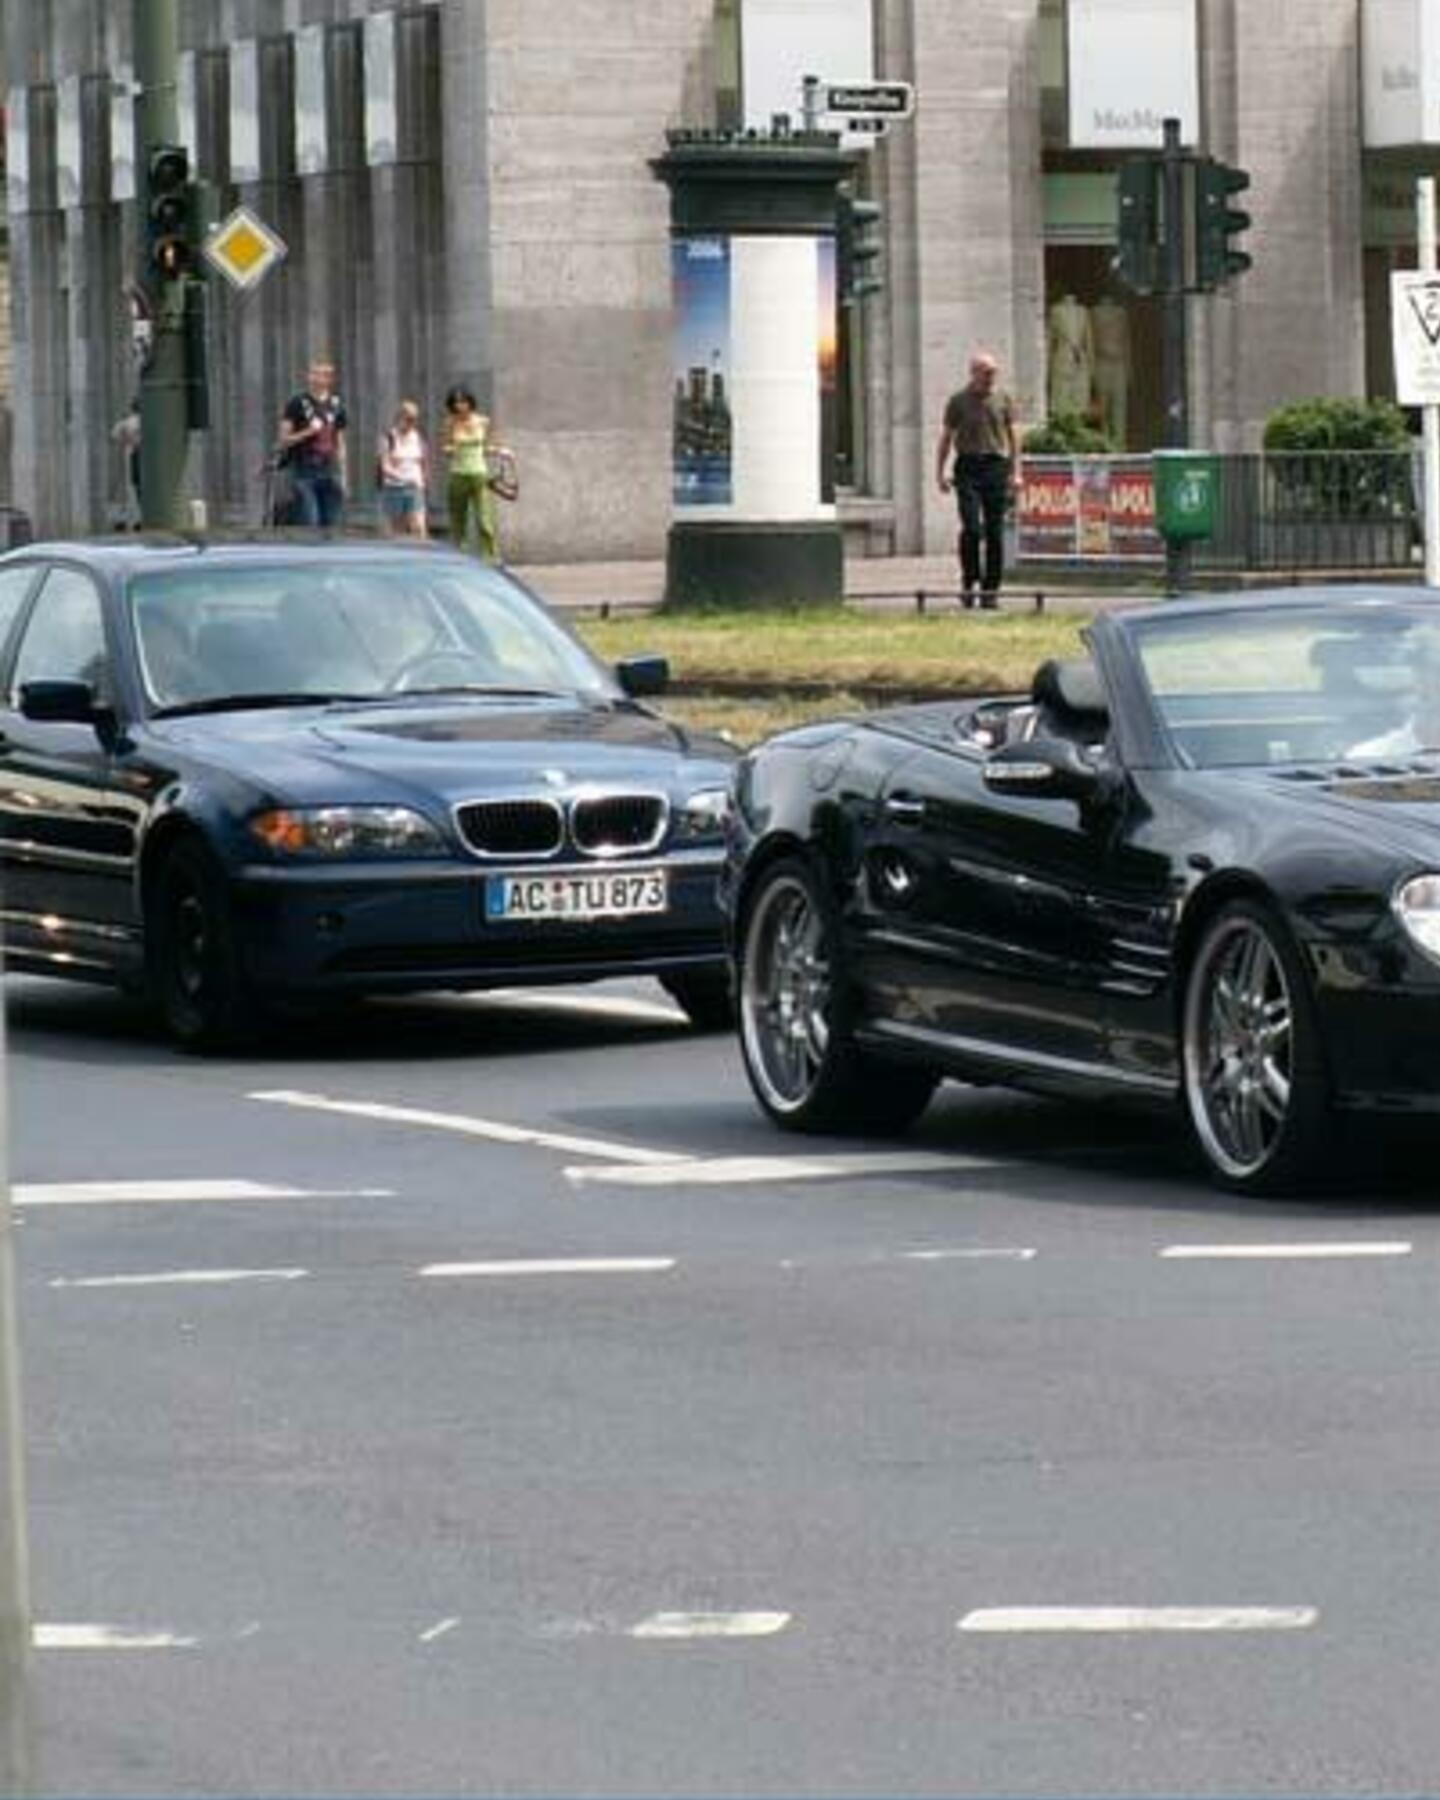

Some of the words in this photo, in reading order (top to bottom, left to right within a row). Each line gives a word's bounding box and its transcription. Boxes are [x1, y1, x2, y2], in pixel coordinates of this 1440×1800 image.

[509, 882, 546, 913] AC
[569, 879, 605, 911] TU
[611, 877, 664, 910] 873
